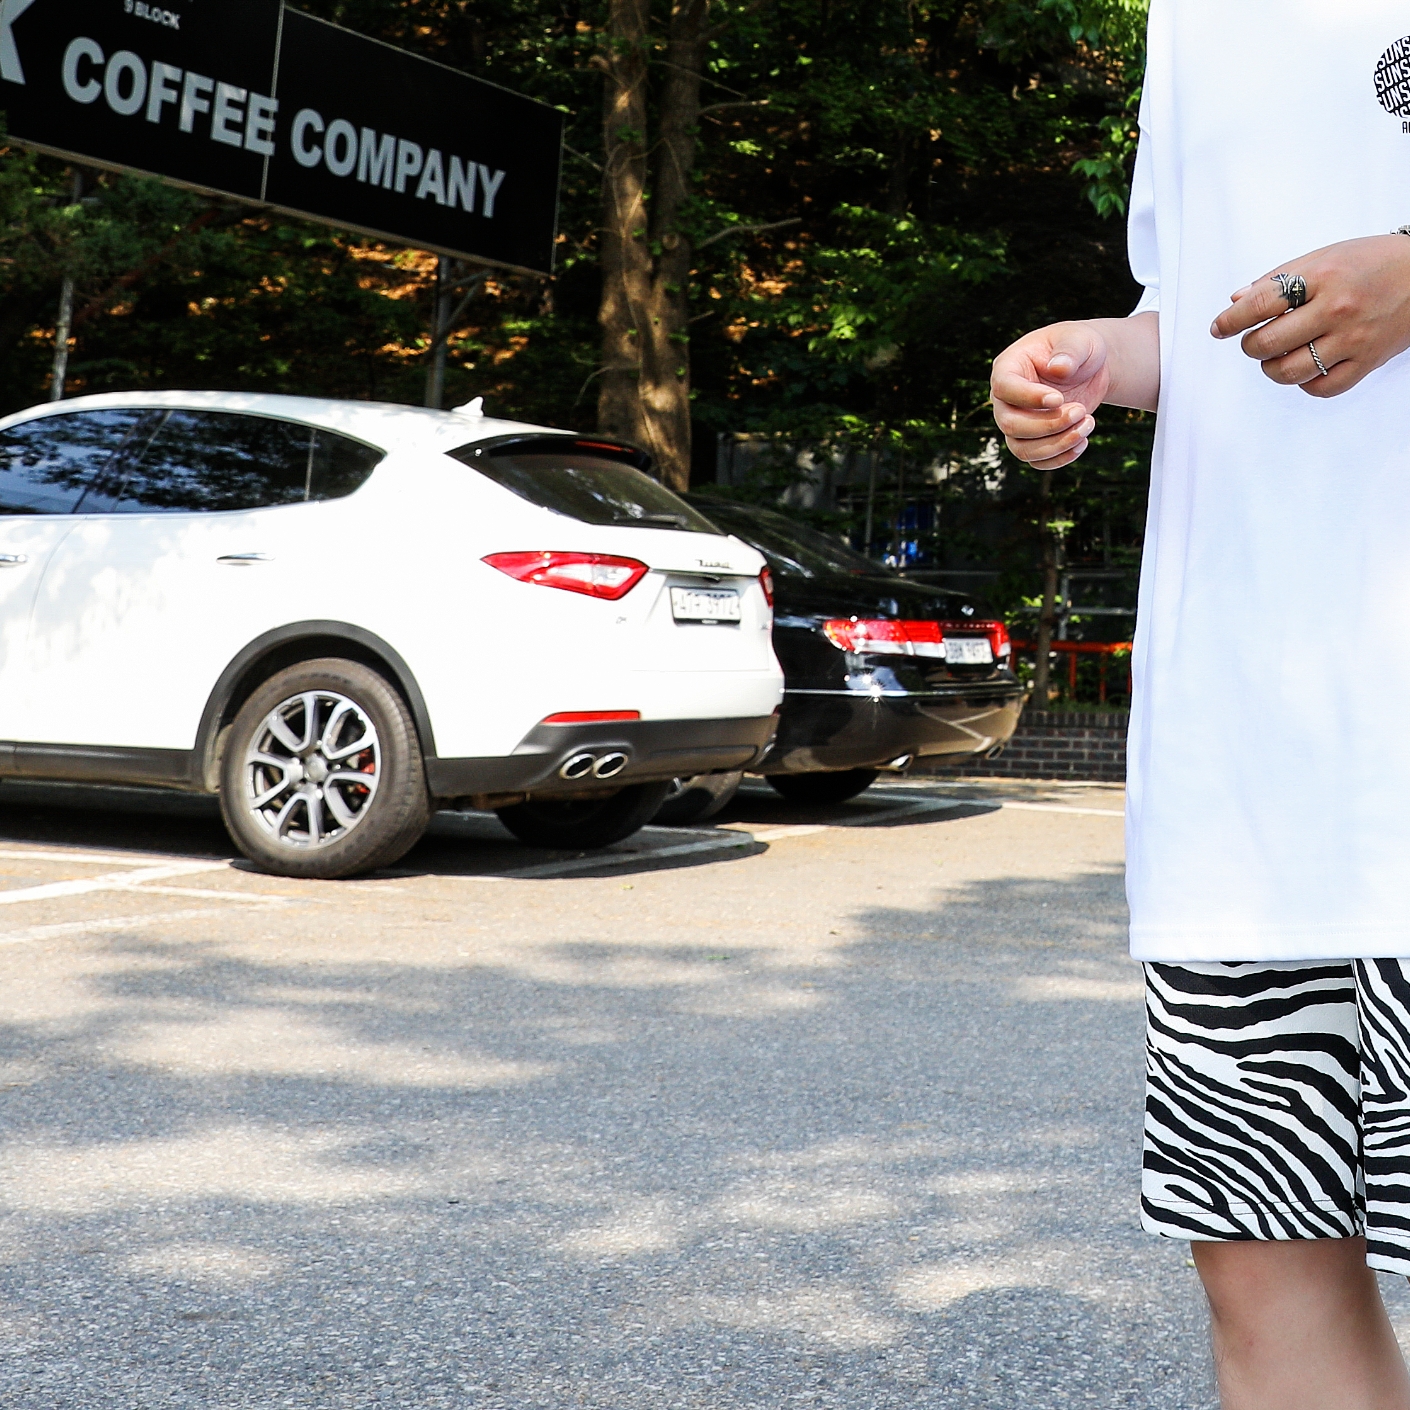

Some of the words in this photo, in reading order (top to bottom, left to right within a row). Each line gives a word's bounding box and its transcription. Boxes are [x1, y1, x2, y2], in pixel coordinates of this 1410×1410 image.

[135, 0, 181, 30] BLOCK
[61, 36, 279, 157] COFFEE
[291, 107, 507, 219] COMPANY
